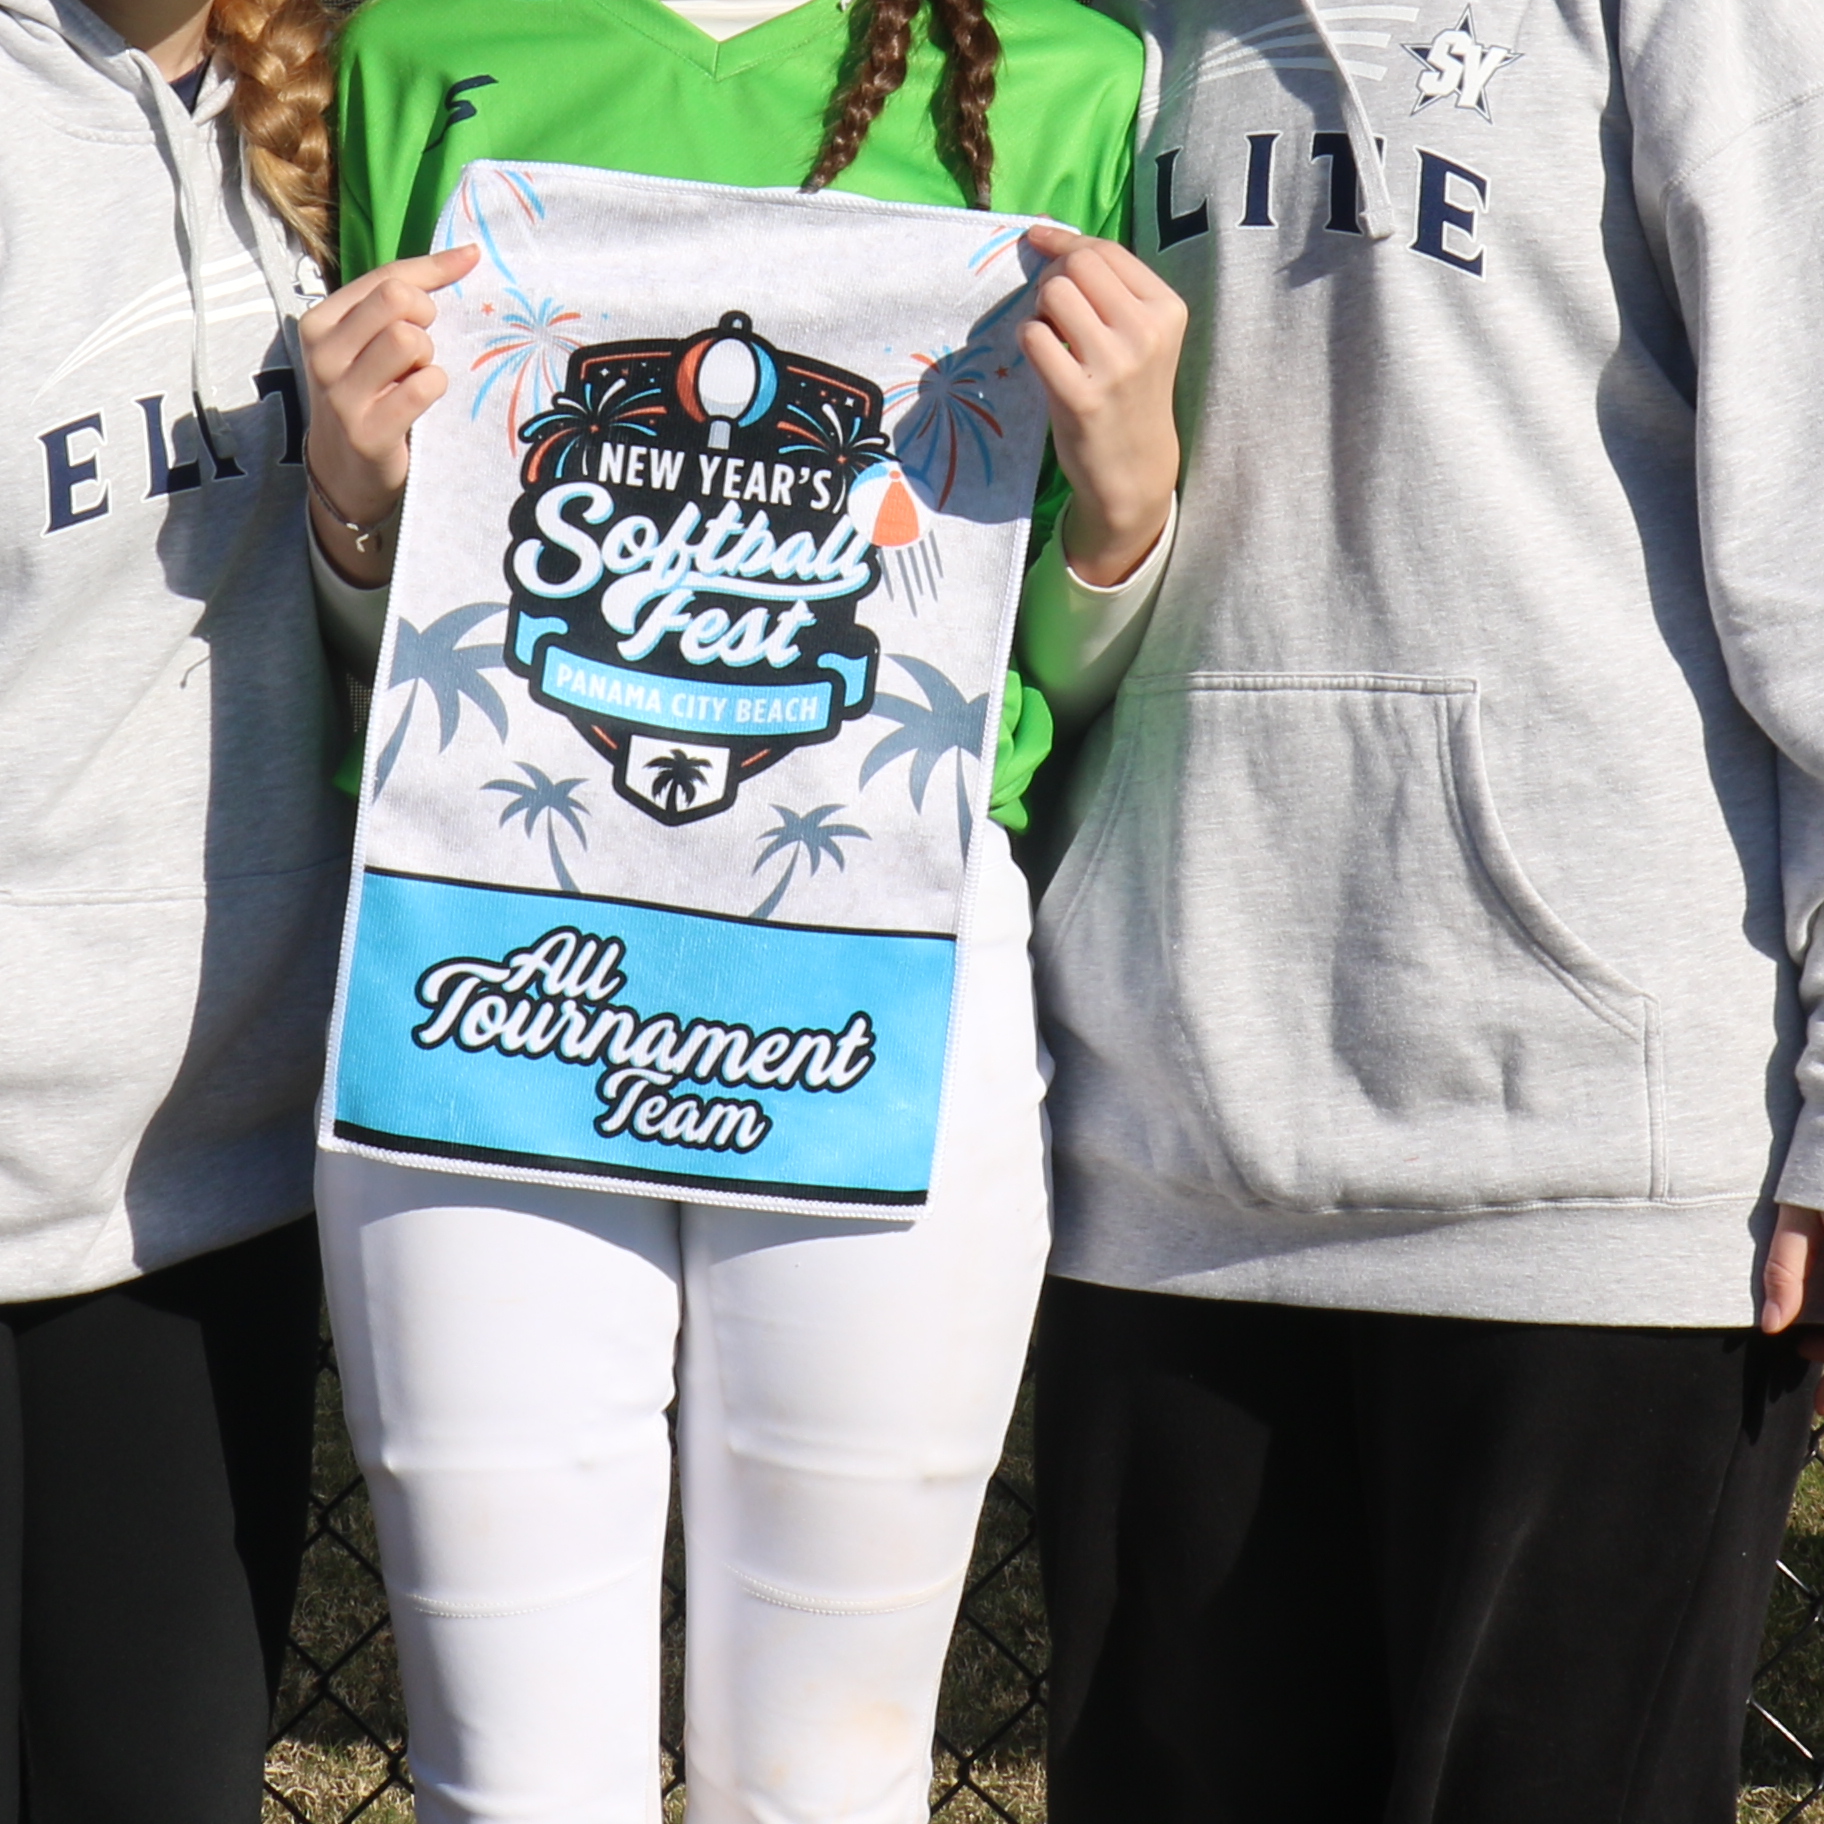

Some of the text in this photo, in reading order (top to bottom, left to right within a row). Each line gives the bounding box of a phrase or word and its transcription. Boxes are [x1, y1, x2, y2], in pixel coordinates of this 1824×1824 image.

[1416, 28, 1510, 108] SY
[598, 442, 832, 511] NEW YEAR'S
[513, 481, 871, 600] Softball
[601, 570, 818, 668] Fest
[556, 664, 819, 725] PANAMA CITY BEACH
[506, 930, 622, 999] All
[418, 961, 873, 1087] Tournament
[597, 1069, 766, 1149] Team
